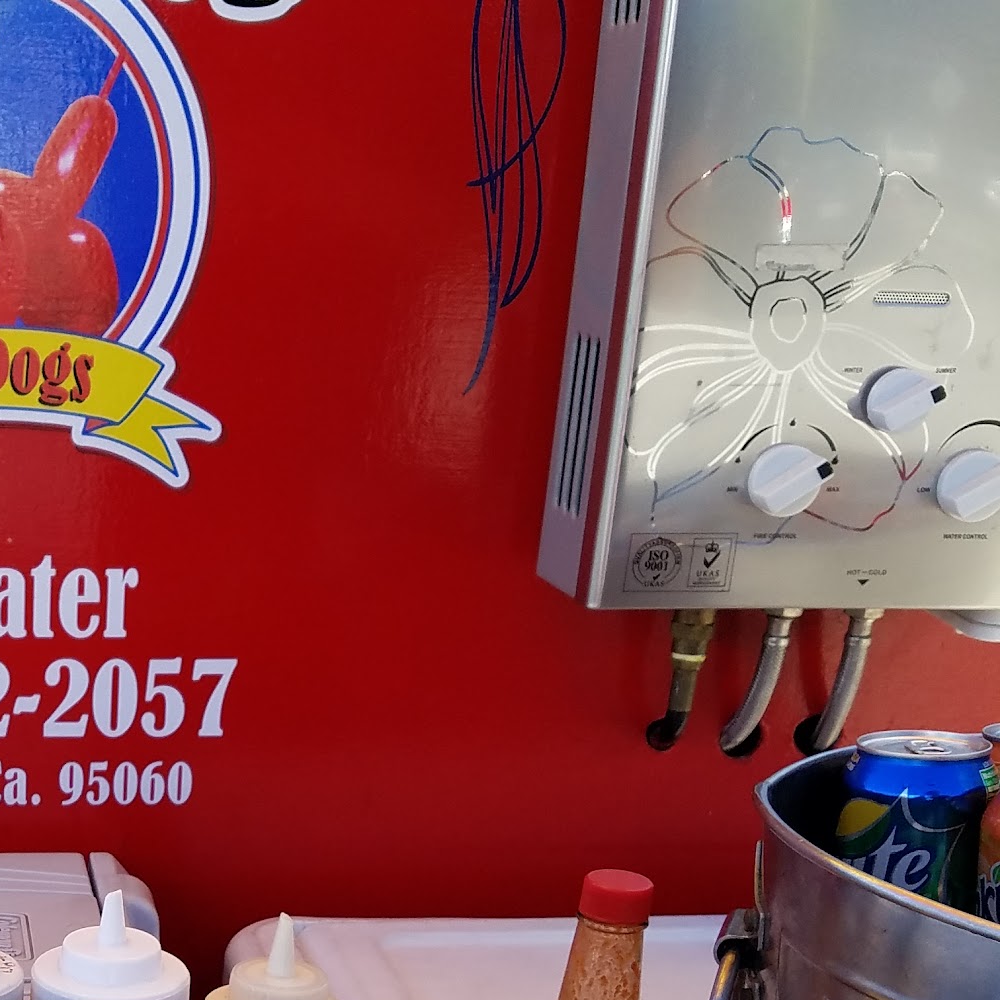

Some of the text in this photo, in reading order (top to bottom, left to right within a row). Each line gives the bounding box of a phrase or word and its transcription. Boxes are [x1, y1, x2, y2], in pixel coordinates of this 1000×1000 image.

[649, 550, 669, 560] ISO
[645, 561, 668, 571] 9001
[59, 760, 193, 806] 95060
